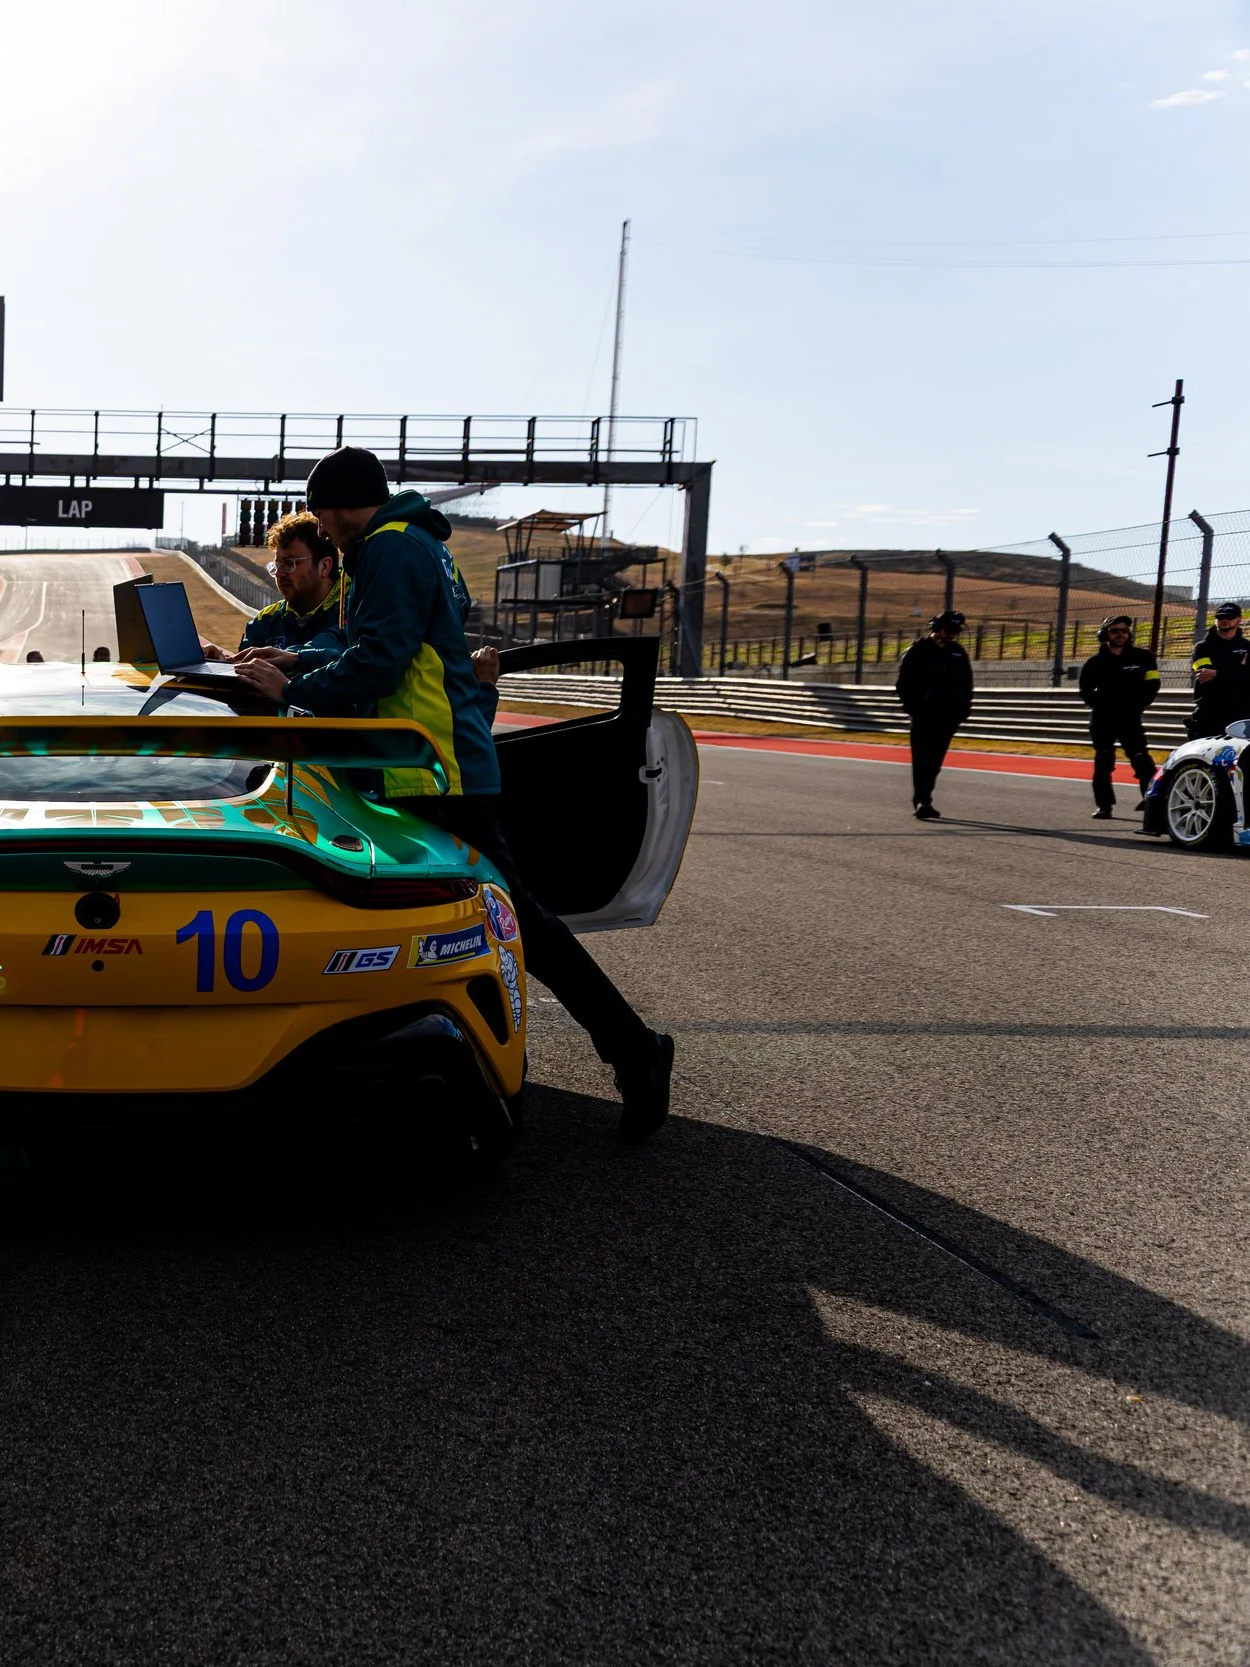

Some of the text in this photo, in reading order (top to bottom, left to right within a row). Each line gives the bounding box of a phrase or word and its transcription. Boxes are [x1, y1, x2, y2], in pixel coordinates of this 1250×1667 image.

[58, 500, 93, 519] LAP
[74, 938, 143, 955] IMSA
[176, 909, 280, 992] 10
[439, 934, 482, 956] MICHELIN
[355, 951, 393, 968] GS
